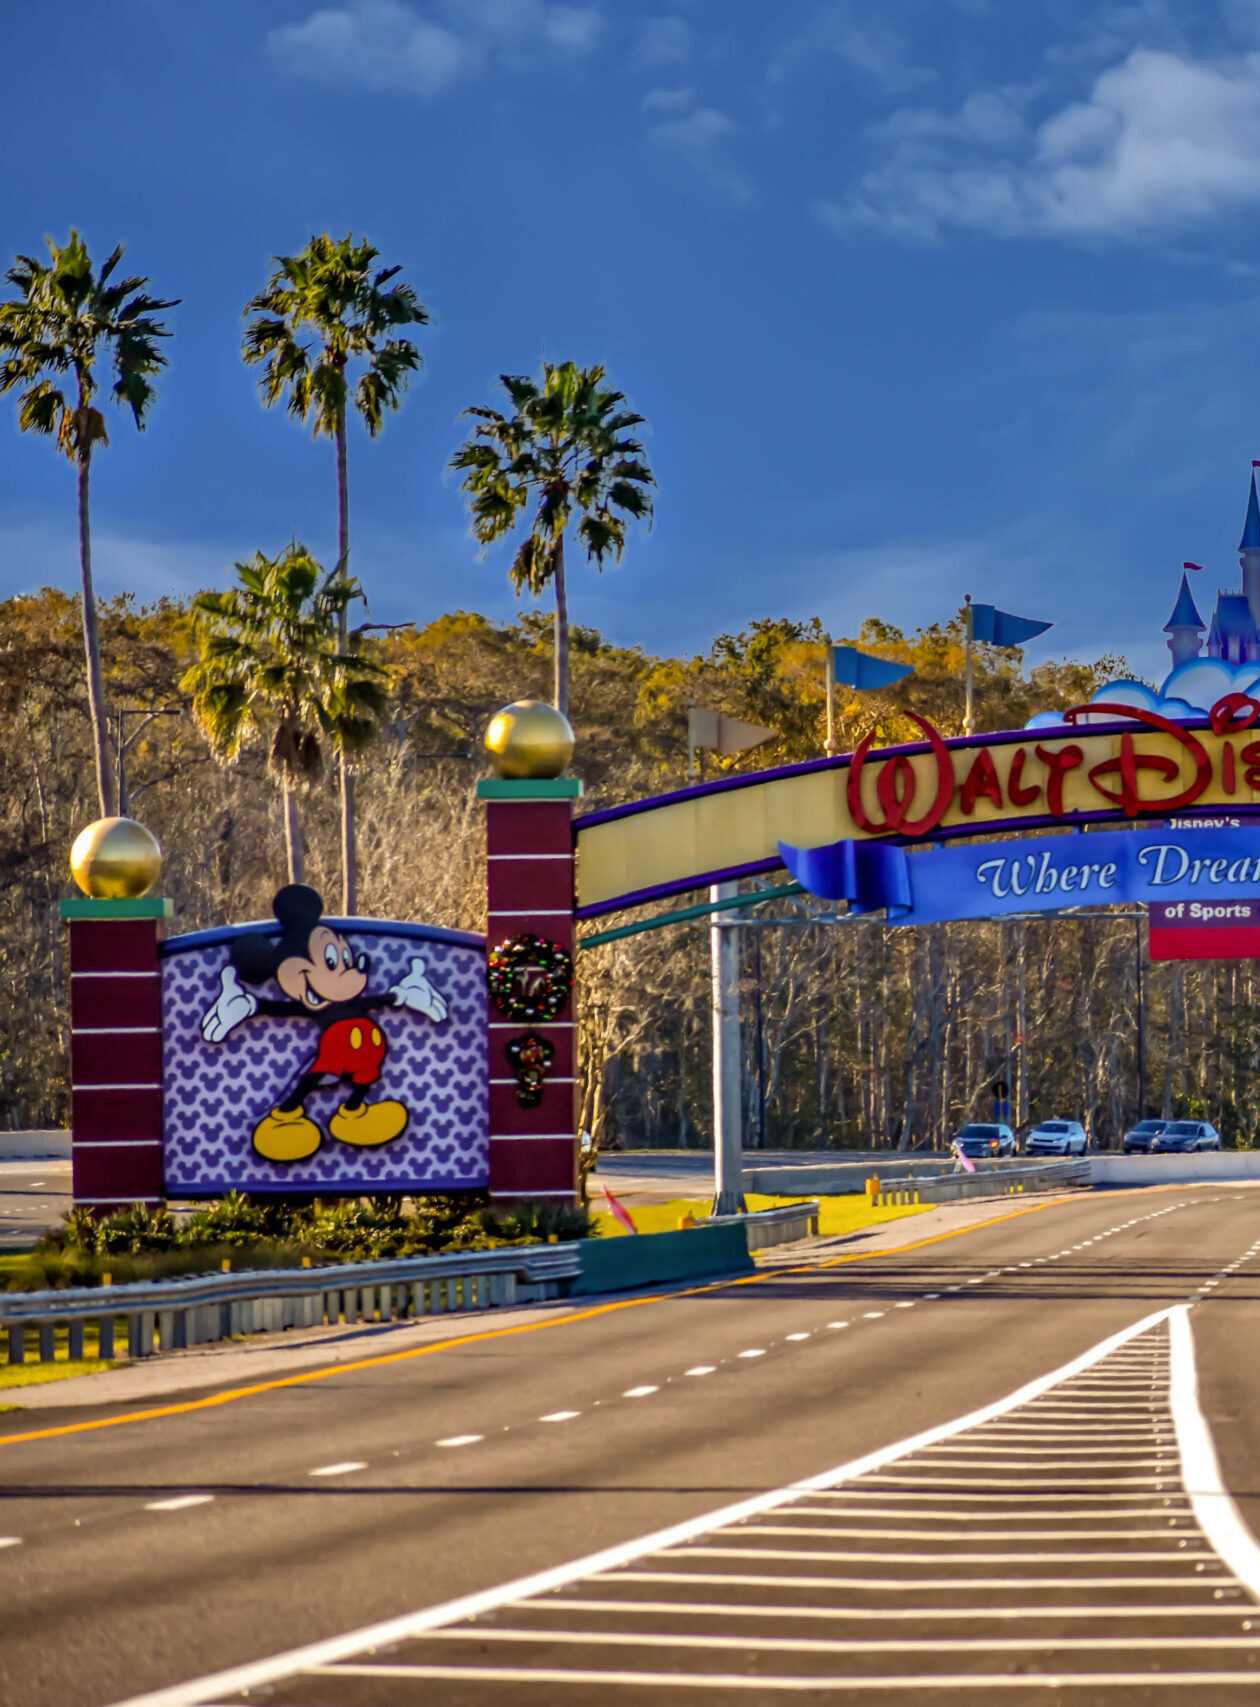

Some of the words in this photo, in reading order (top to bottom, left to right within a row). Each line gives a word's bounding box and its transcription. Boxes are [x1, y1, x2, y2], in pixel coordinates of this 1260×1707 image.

[976, 851, 1117, 898] Where
[1164, 903, 1185, 918] of
[1189, 903, 1251, 921] Sports
